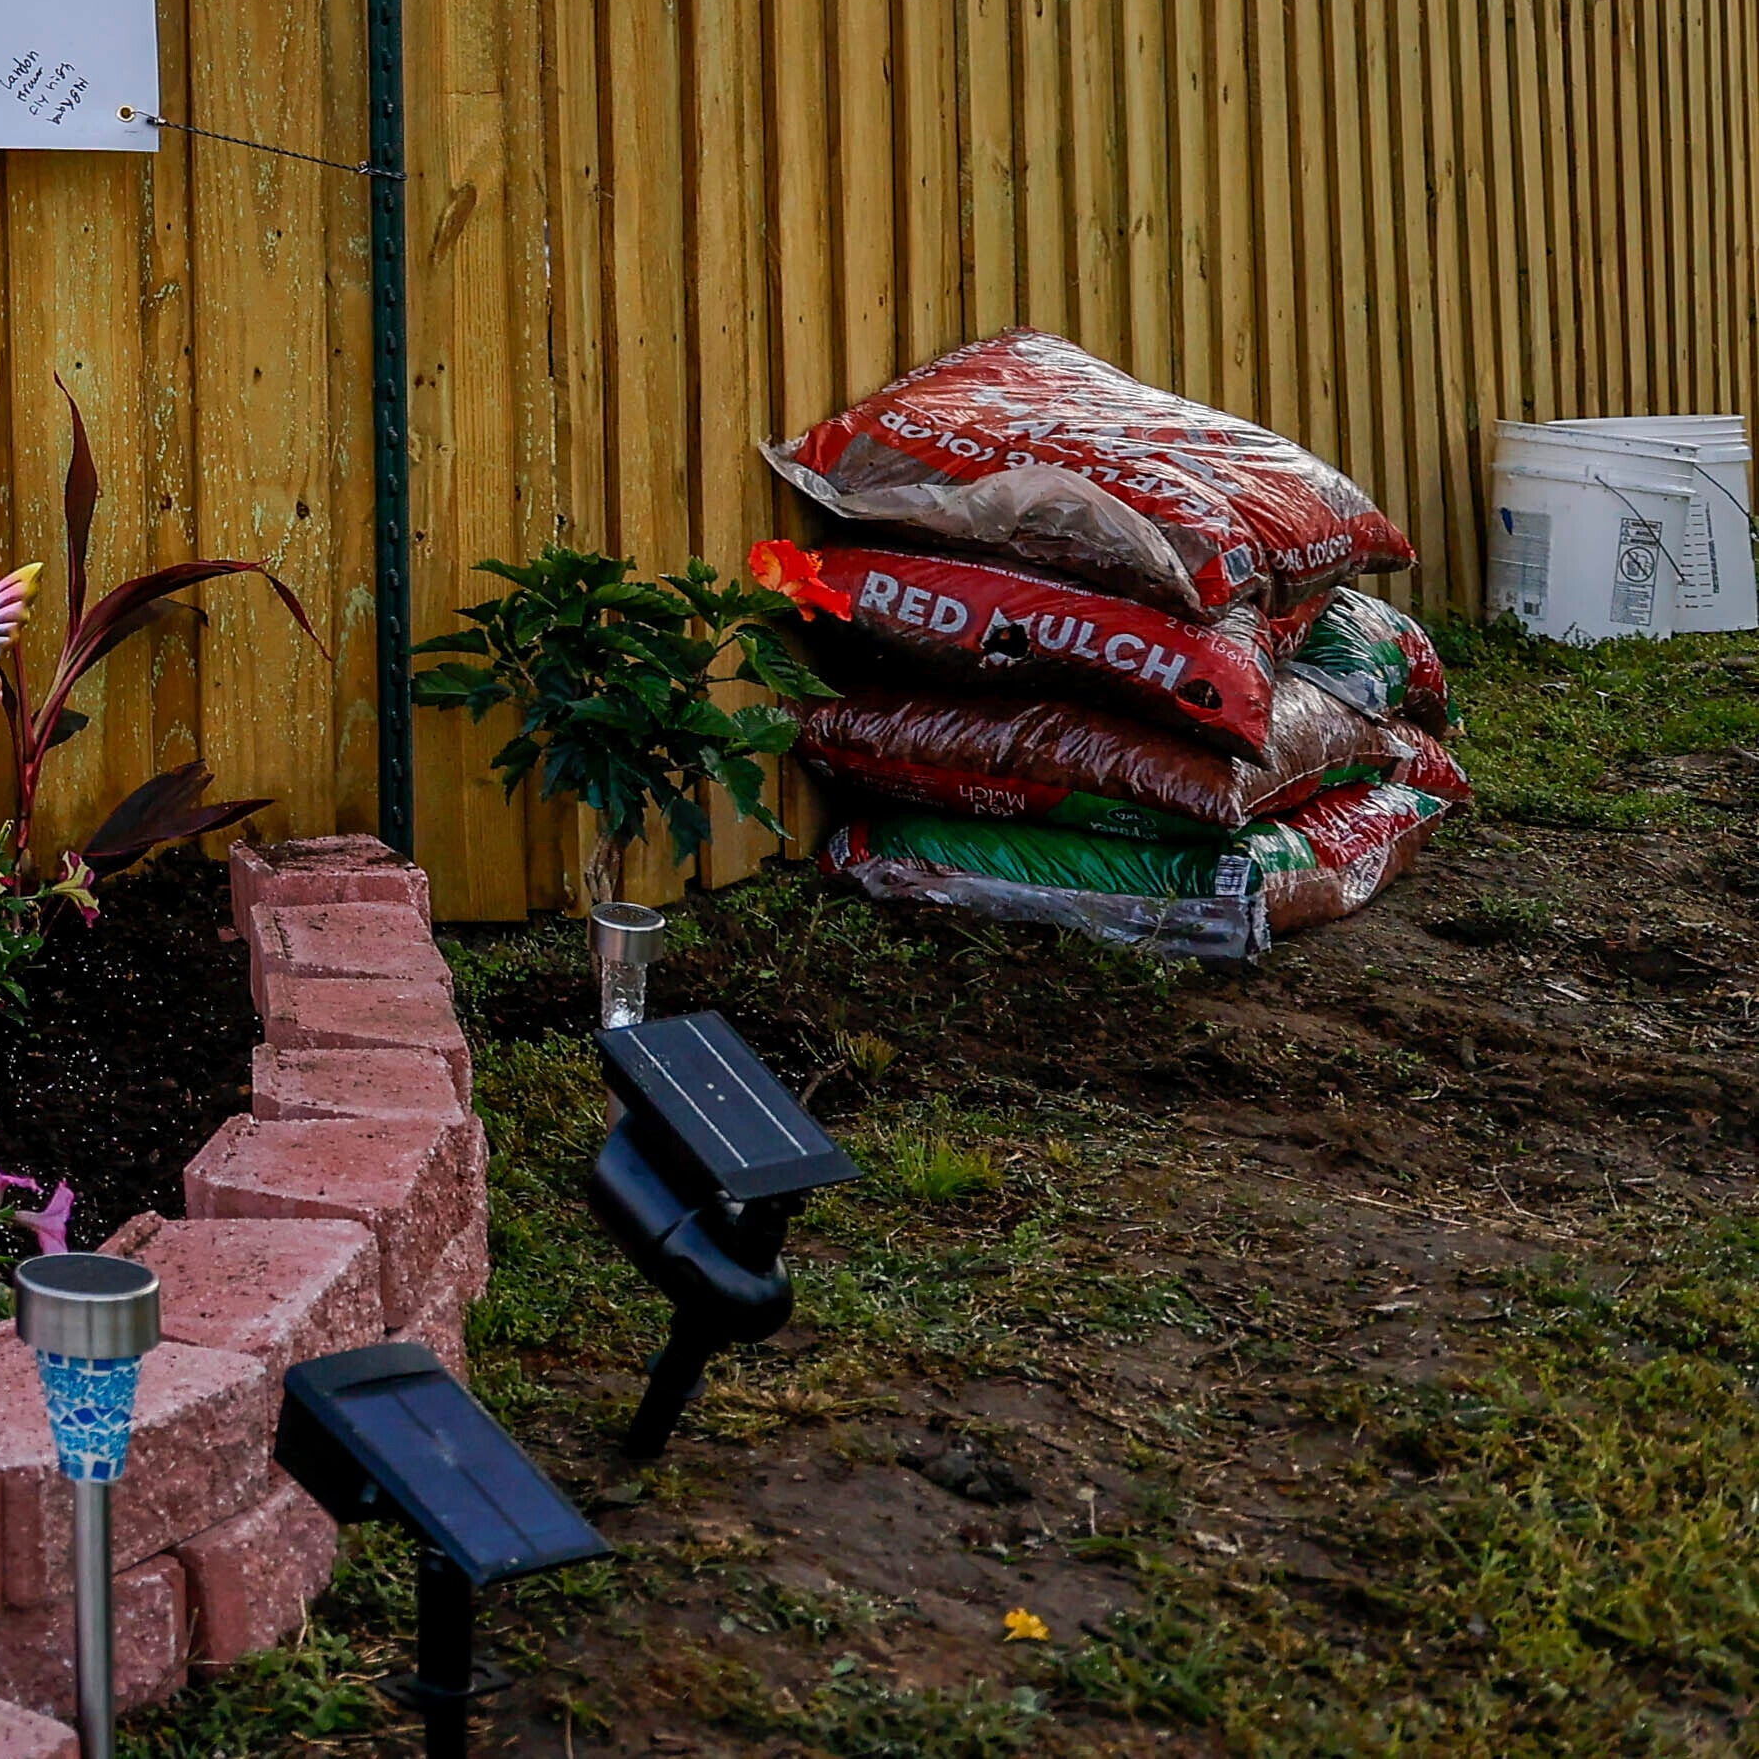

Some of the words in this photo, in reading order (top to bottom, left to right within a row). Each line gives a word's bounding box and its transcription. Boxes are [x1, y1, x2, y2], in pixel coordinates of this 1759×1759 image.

[858, 570, 968, 634] RED
[1165, 617, 1178, 629] 2
[1183, 625, 1206, 640] CF
[958, 784, 1025, 811] Mulch
